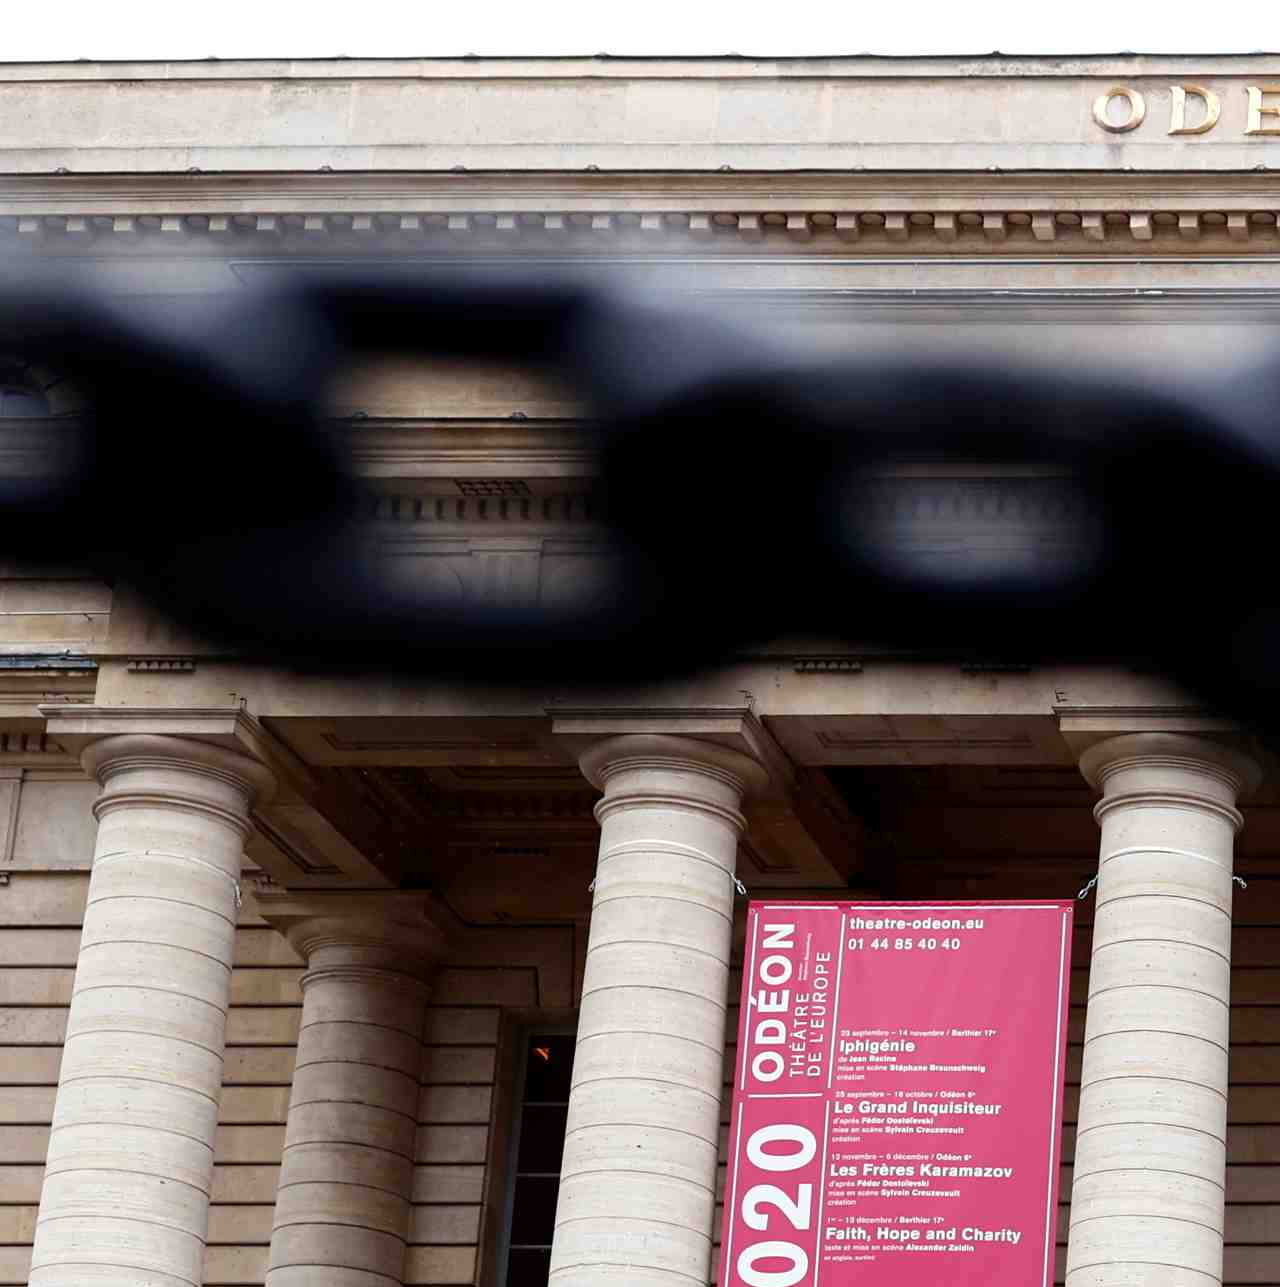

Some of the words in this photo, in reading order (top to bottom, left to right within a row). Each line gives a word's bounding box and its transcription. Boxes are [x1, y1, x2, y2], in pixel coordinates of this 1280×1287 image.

[850, 917, 983, 929] theatre-odeon.eu
[848, 938, 863, 950] 01
[871, 938, 888, 950] 44
[895, 938, 912, 950] 85
[918, 938, 936, 950] 40
[942, 938, 960, 950] 40
[749, 924, 795, 1082] ODÉON
[810, 952, 831, 1043] L'EUROPE
[789, 992, 809, 1078] THÉÂTRE
[840, 1039, 915, 1054] Iphigénie
[807, 1052, 822, 1077] DE
[834, 1102, 853, 1113] Le
[859, 1101, 907, 1114] Grand
[913, 1101, 1001, 1116] Inquisiteur
[830, 1164, 857, 1176] Les
[863, 1163, 914, 1176] Frères
[920, 1164, 1012, 1177] Karamazov
[826, 1228, 871, 1241] Faith,
[877, 1228, 920, 1243] Hope
[926, 1228, 956, 1240] and
[962, 1228, 1021, 1244] Charity
